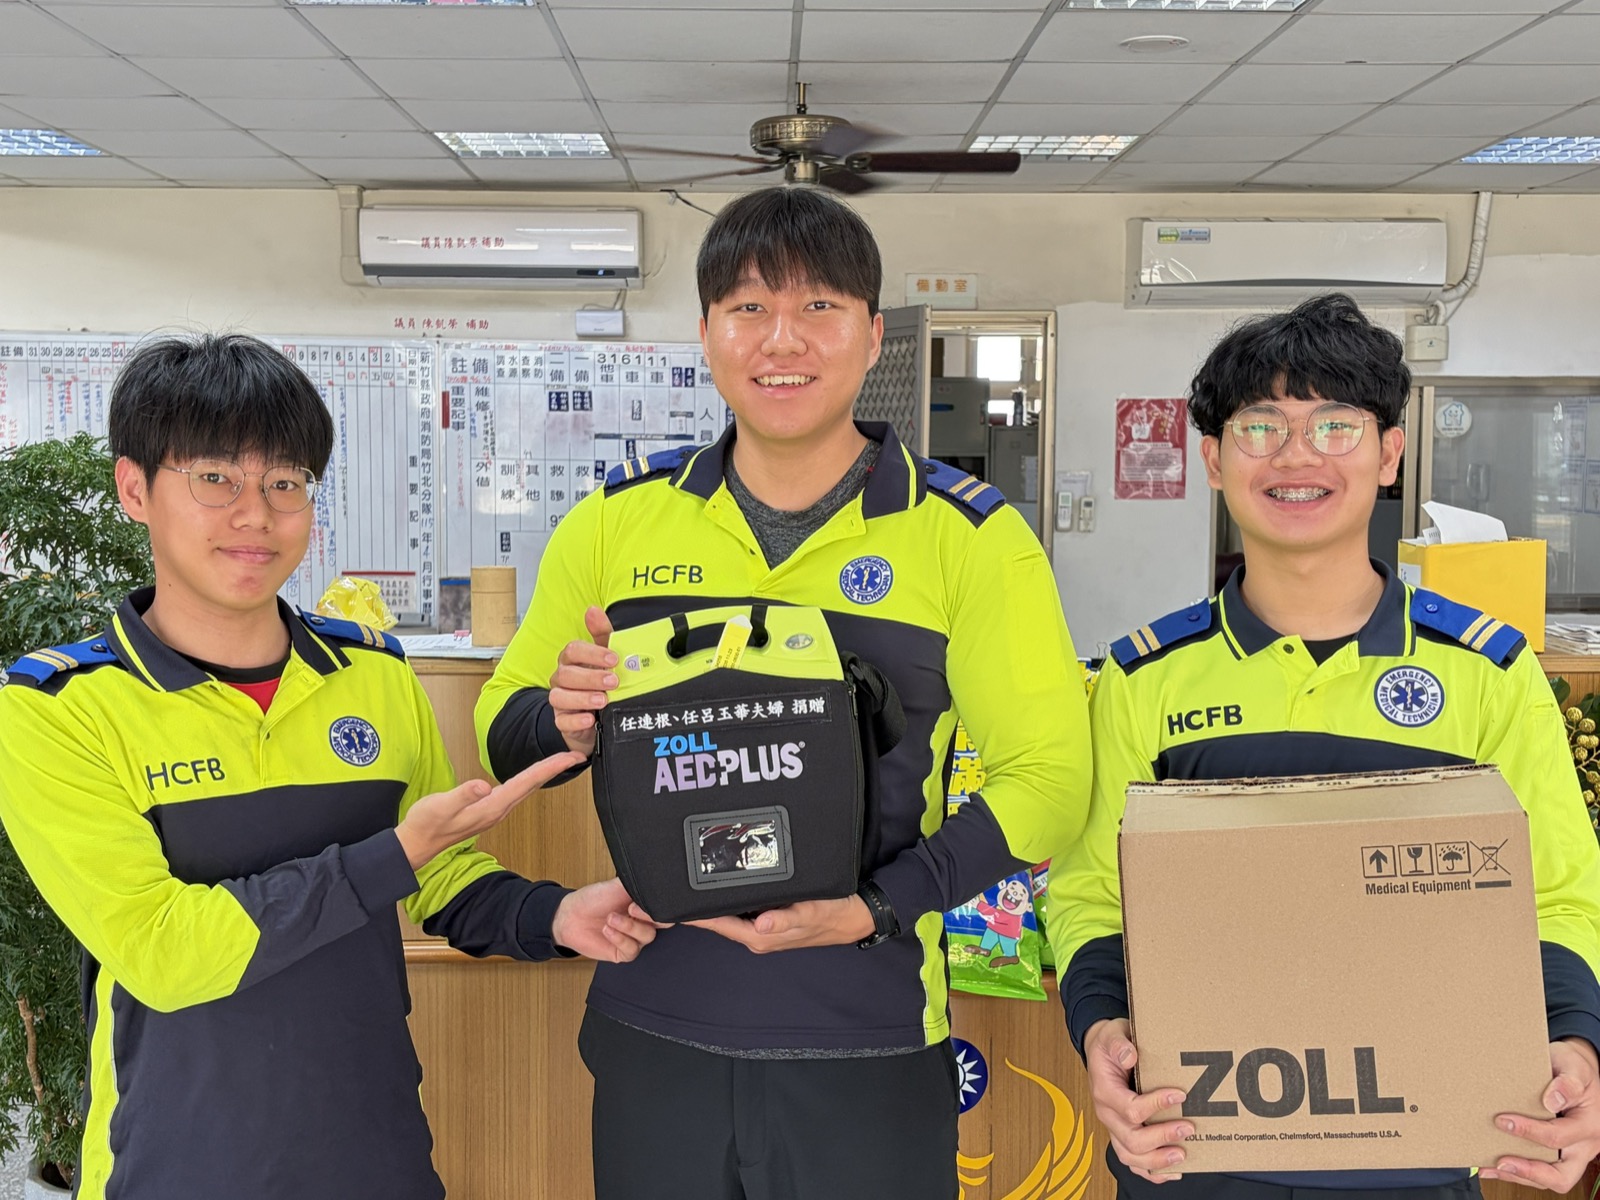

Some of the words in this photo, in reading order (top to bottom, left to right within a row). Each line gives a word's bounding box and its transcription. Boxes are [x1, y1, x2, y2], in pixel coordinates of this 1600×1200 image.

[466, 318, 489, 331] 補助
[29, 347, 38, 357] 31
[41, 347, 51, 357] 30
[53, 347, 63, 357] 29
[65, 347, 75, 357] 28
[77, 347, 87, 357] 27
[89, 347, 100, 357] 26
[101, 347, 112, 357] 25
[298, 351, 305, 361] 9
[311, 351, 317, 361] 8
[323, 351, 329, 361] 7
[347, 352, 354, 361] 5
[359, 352, 366, 362] 4
[631, 564, 704, 588] HCFB
[1385, 670, 1435, 689] EMERGENCY
[1379, 685, 1399, 719] MEDICAL
[1401, 692, 1439, 723] TECHNICIAN
[1166, 703, 1243, 736] HCFB
[653, 731, 718, 758] ZOLL
[144, 756, 226, 791] HCFB
[1365, 881, 1410, 896] Medical
[1412, 878, 1472, 895] Equipment
[1179, 1046, 1405, 1119] ZOLL
[1205, 1133, 1233, 1142] Medical
[1233, 1132, 1279, 1143] Corporation,
[1278, 1131, 1323, 1142] Chelmsford,
[1323, 1130, 1378, 1140] Massachusetts
[1379, 1130, 1403, 1139] U.S.A.
